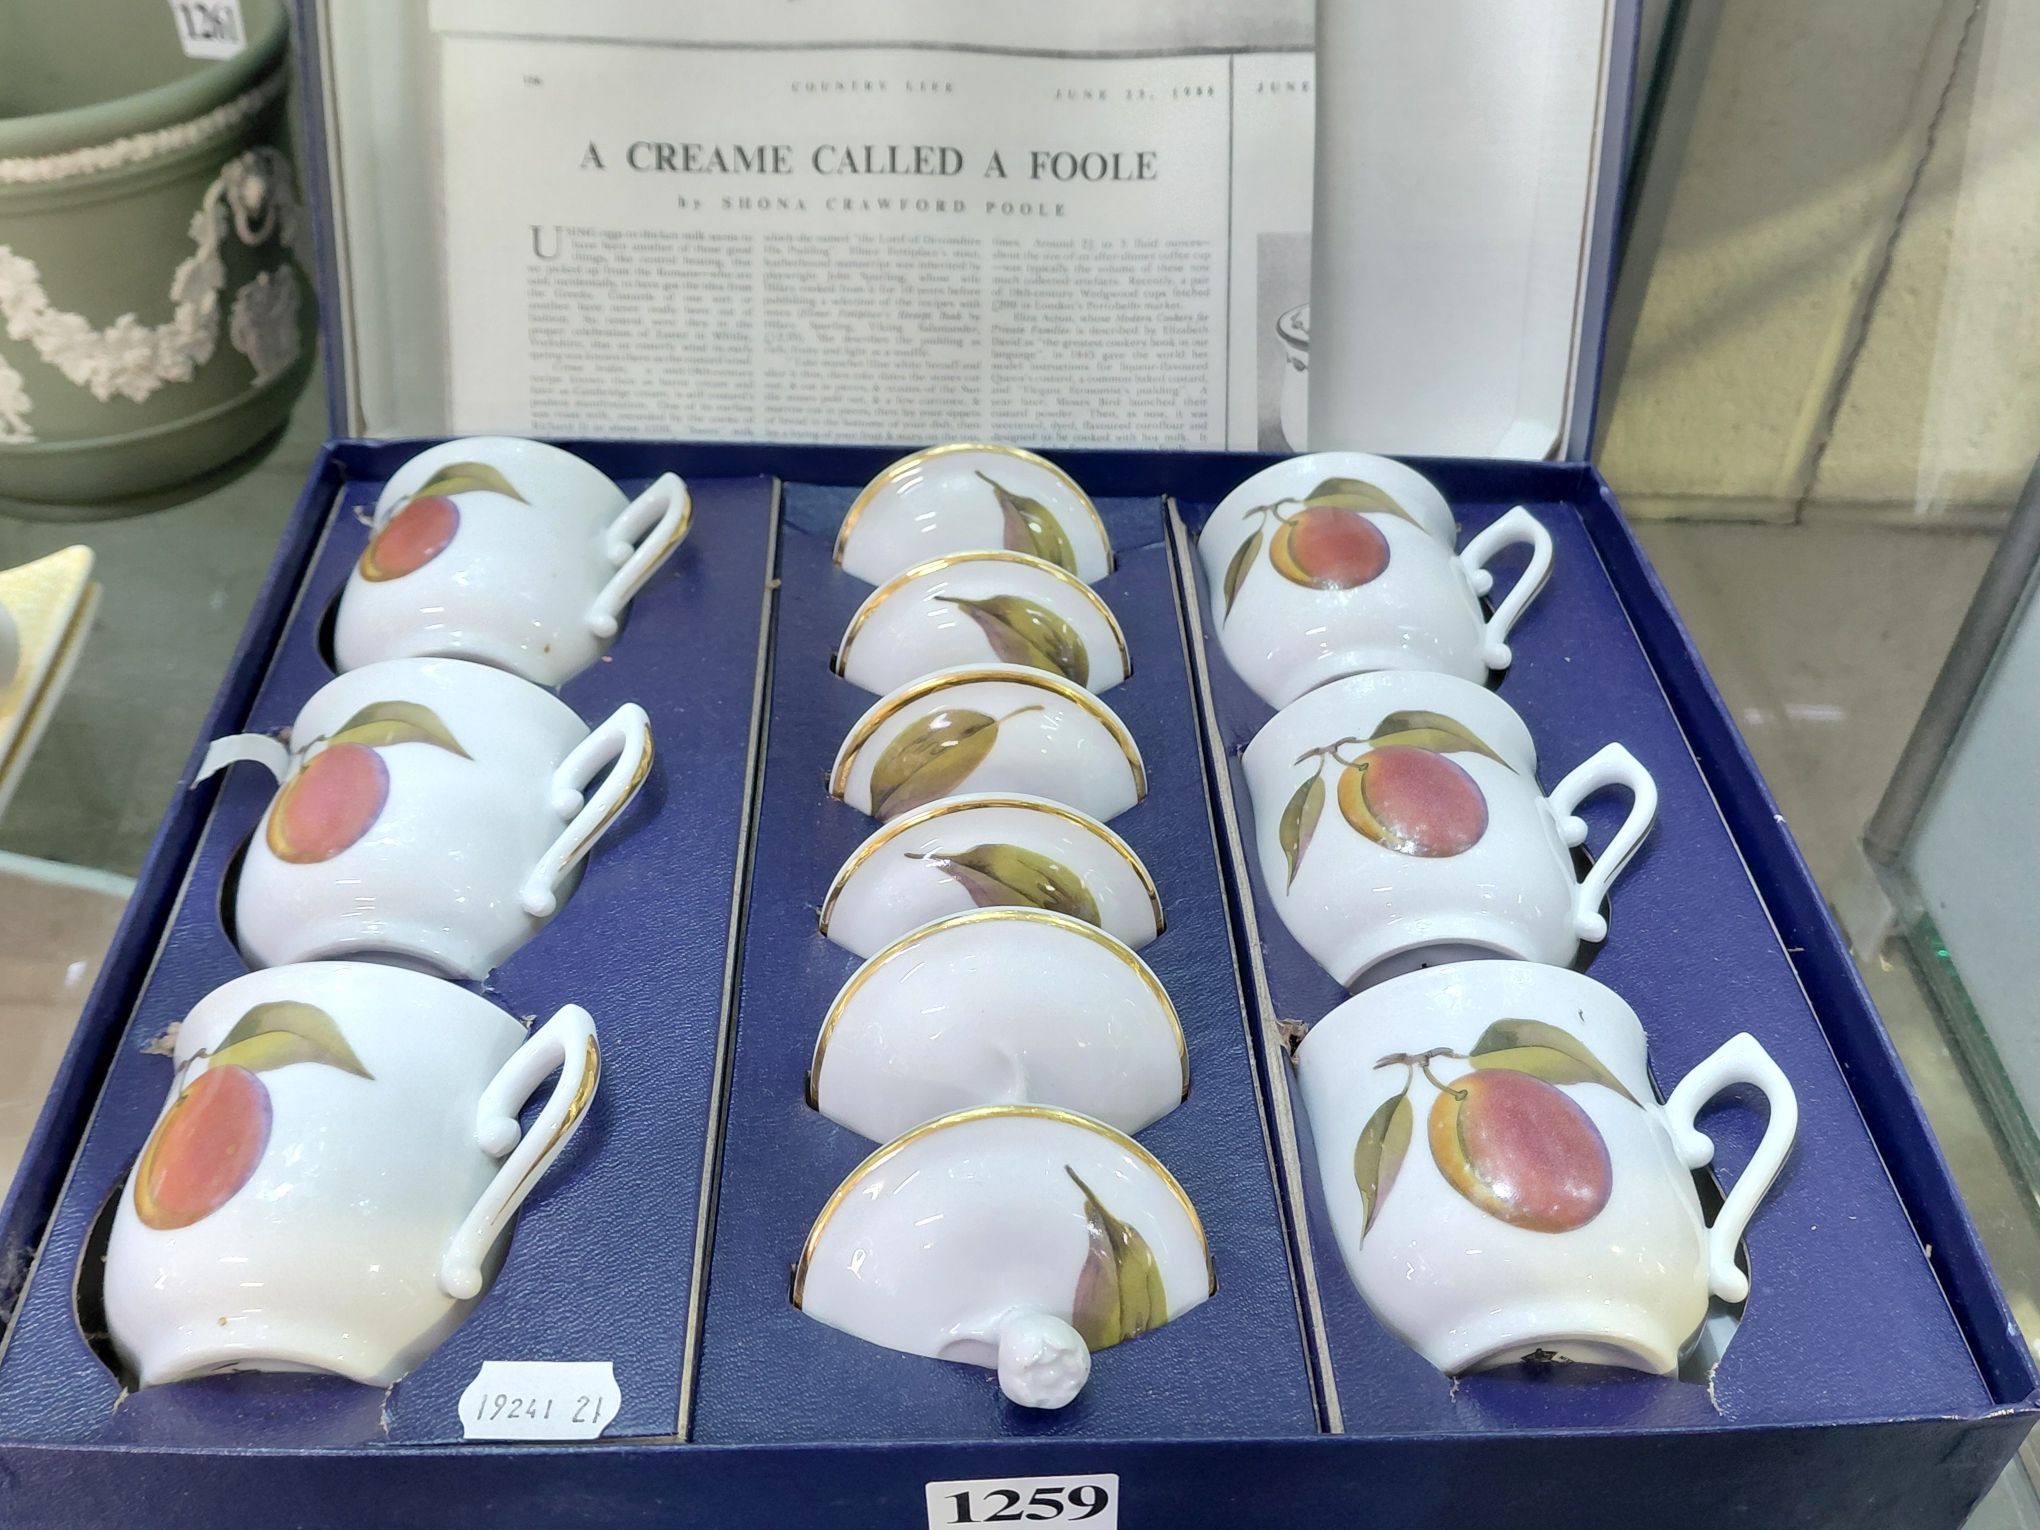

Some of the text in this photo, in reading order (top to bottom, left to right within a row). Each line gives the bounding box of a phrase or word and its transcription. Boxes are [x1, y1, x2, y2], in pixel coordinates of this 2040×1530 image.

[1055, 88, 1107, 101] JUNE
[1256, 80, 1310, 95] JUNE
[580, 139, 1159, 182] A CREAME CALLED A FOOLE
[677, 195, 1066, 217] by SHONA CRAWFORD POOLE
[477, 1394, 552, 1420] 19241
[945, 1485, 1109, 1524] 1259
